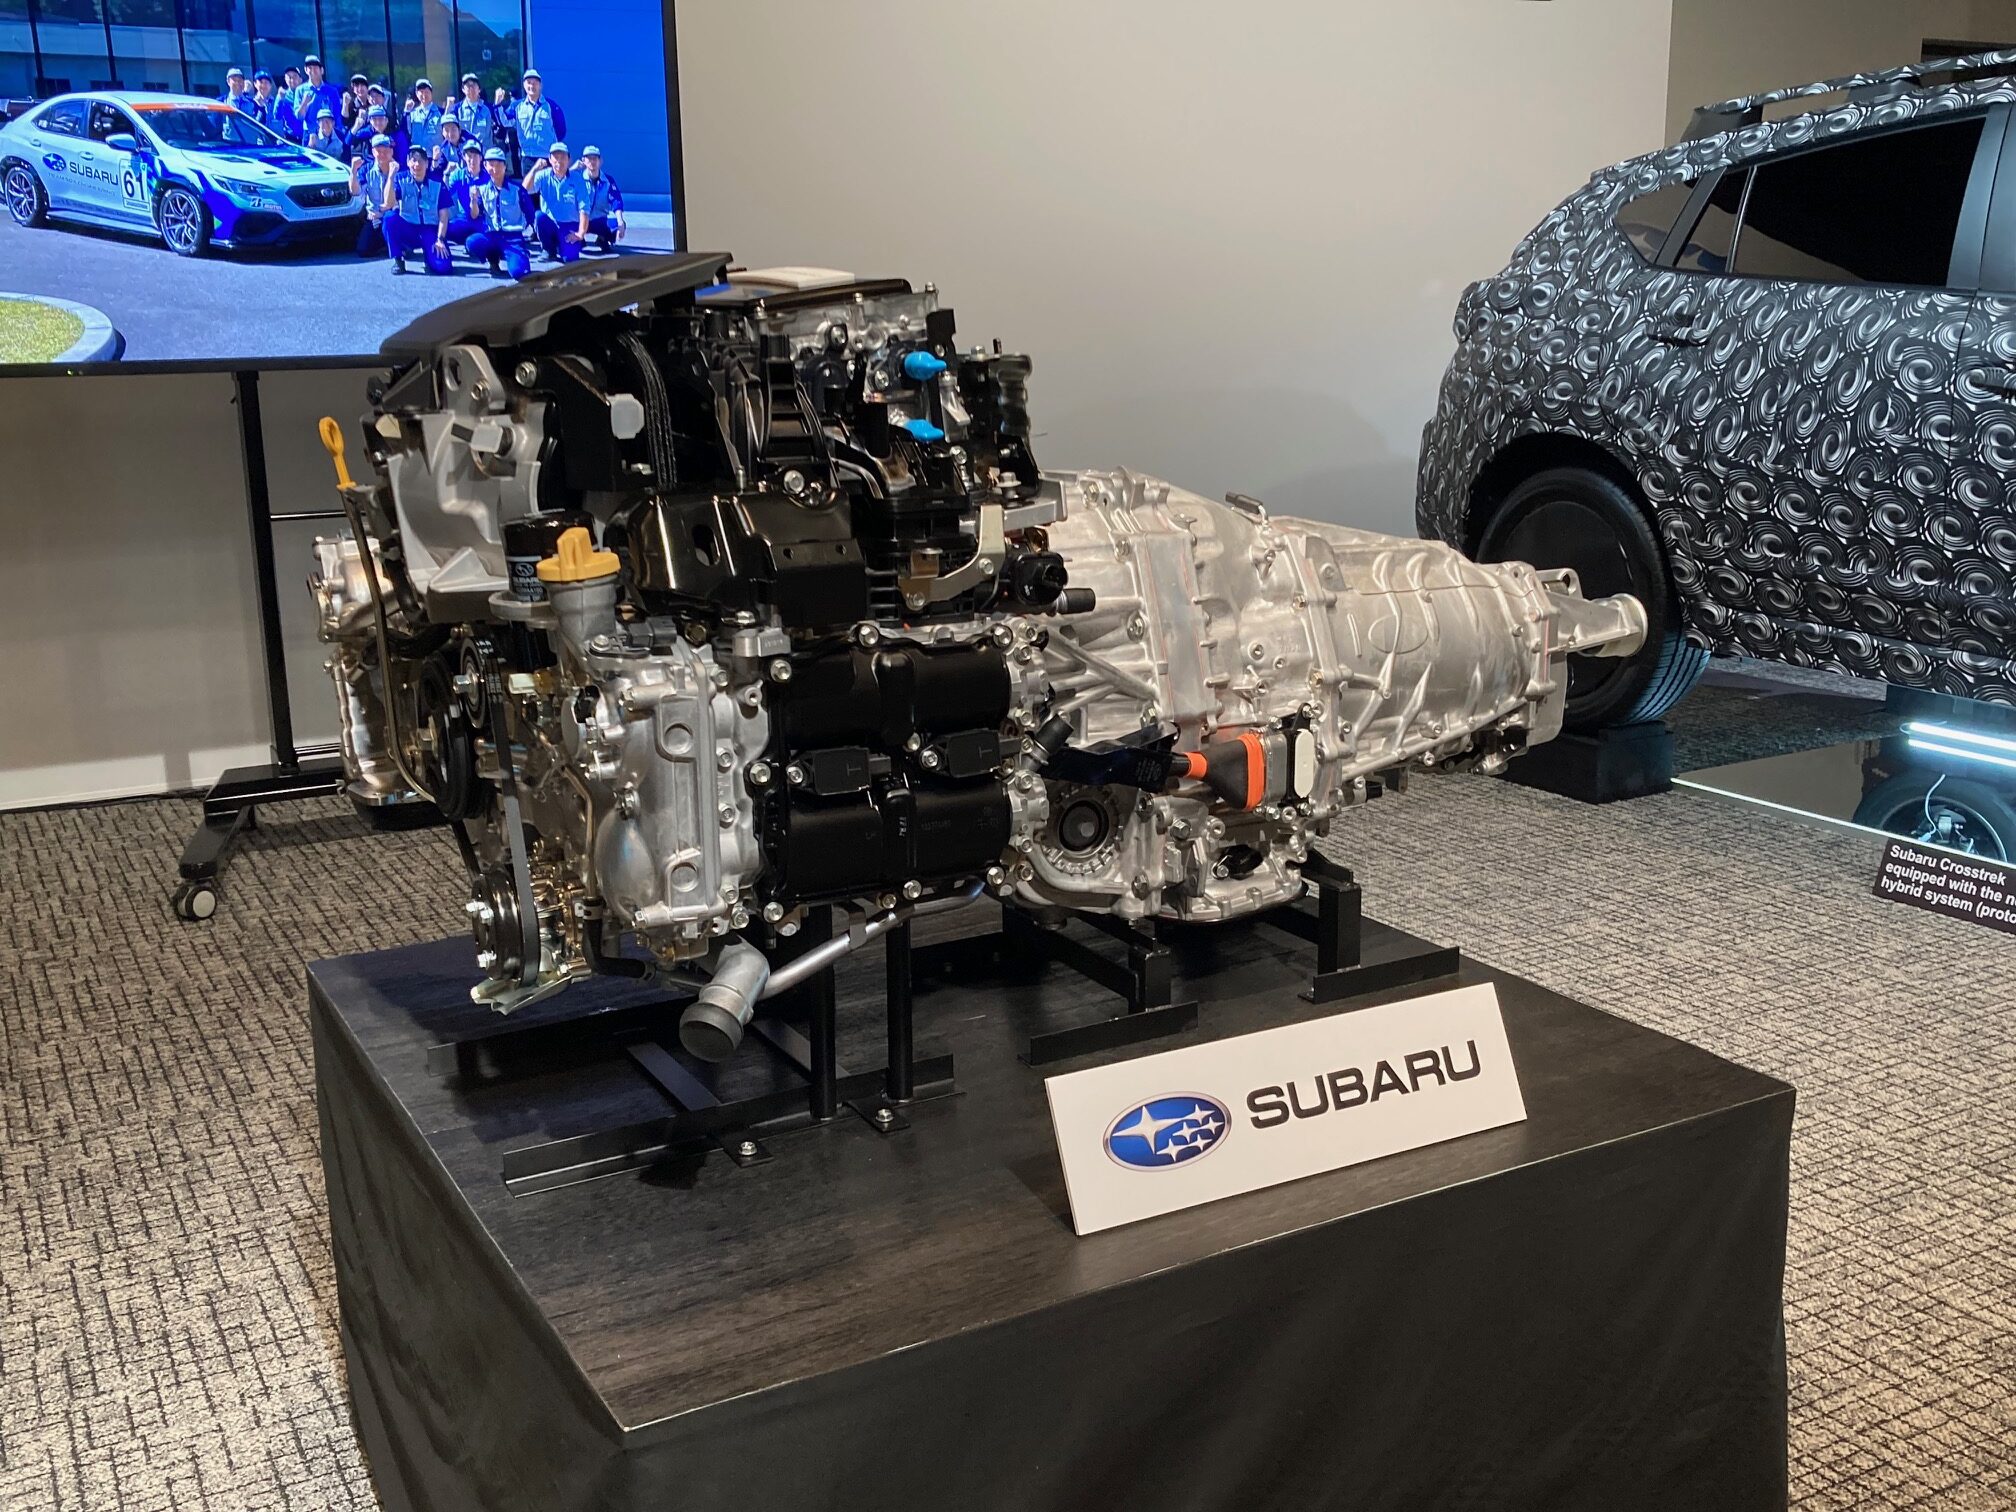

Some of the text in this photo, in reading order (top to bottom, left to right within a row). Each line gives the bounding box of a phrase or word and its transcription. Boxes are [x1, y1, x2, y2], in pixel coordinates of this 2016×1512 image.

[69, 161, 119, 186] SUBARU
[124, 170, 146, 200] 61
[1885, 862, 1947, 888] equipped
[1949, 878, 1978, 896] with
[1980, 885, 2003, 902] the
[1890, 844, 2008, 886] Subaru Crosstrek
[1880, 875, 2016, 924] hybrid system (proto
[1246, 1039, 1482, 1130] SUBARU
